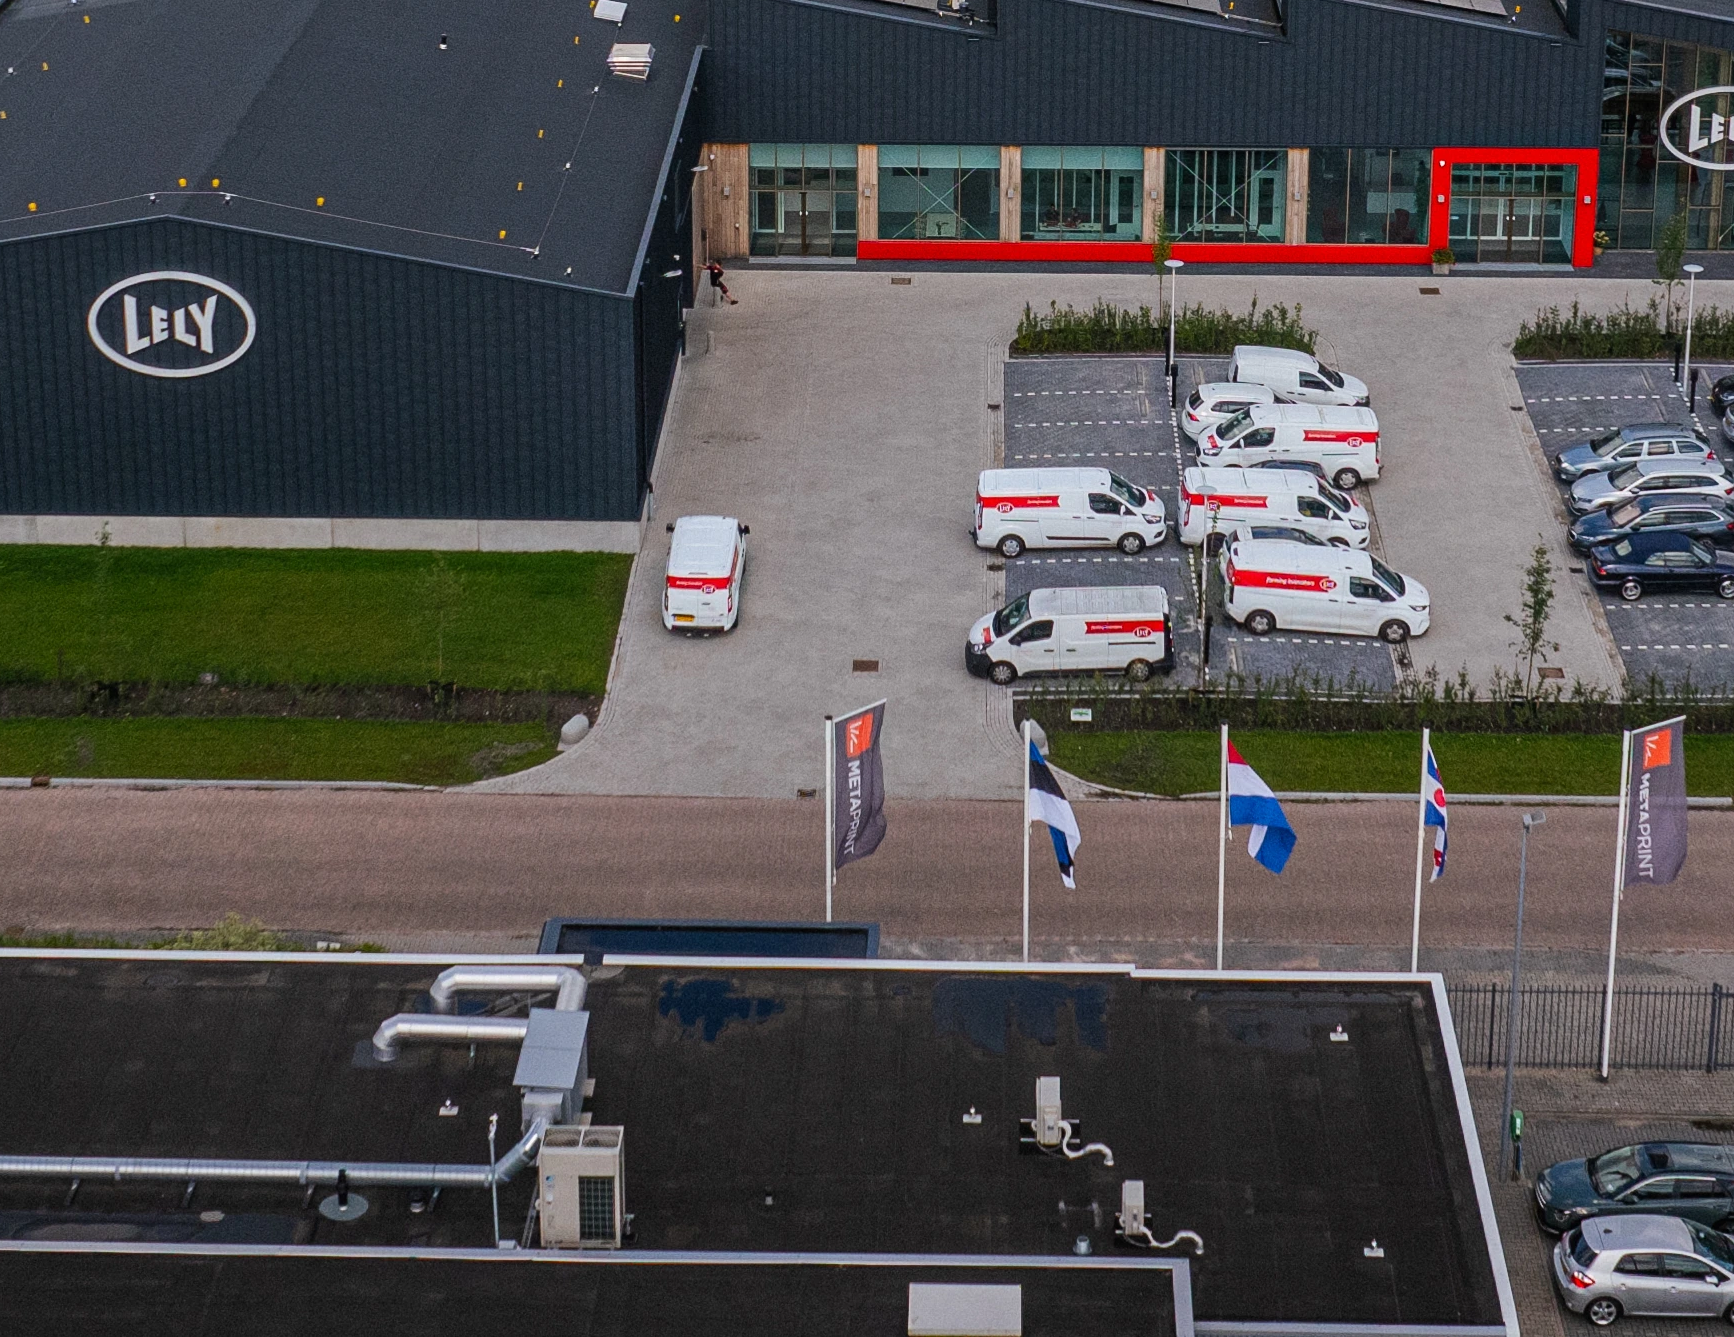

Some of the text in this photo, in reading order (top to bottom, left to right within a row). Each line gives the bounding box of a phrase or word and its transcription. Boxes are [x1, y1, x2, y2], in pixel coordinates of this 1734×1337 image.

[123, 294, 218, 355] LELY
[843, 759, 862, 855] METAPRINT
[1636, 772, 1654, 879] METAPRINT
